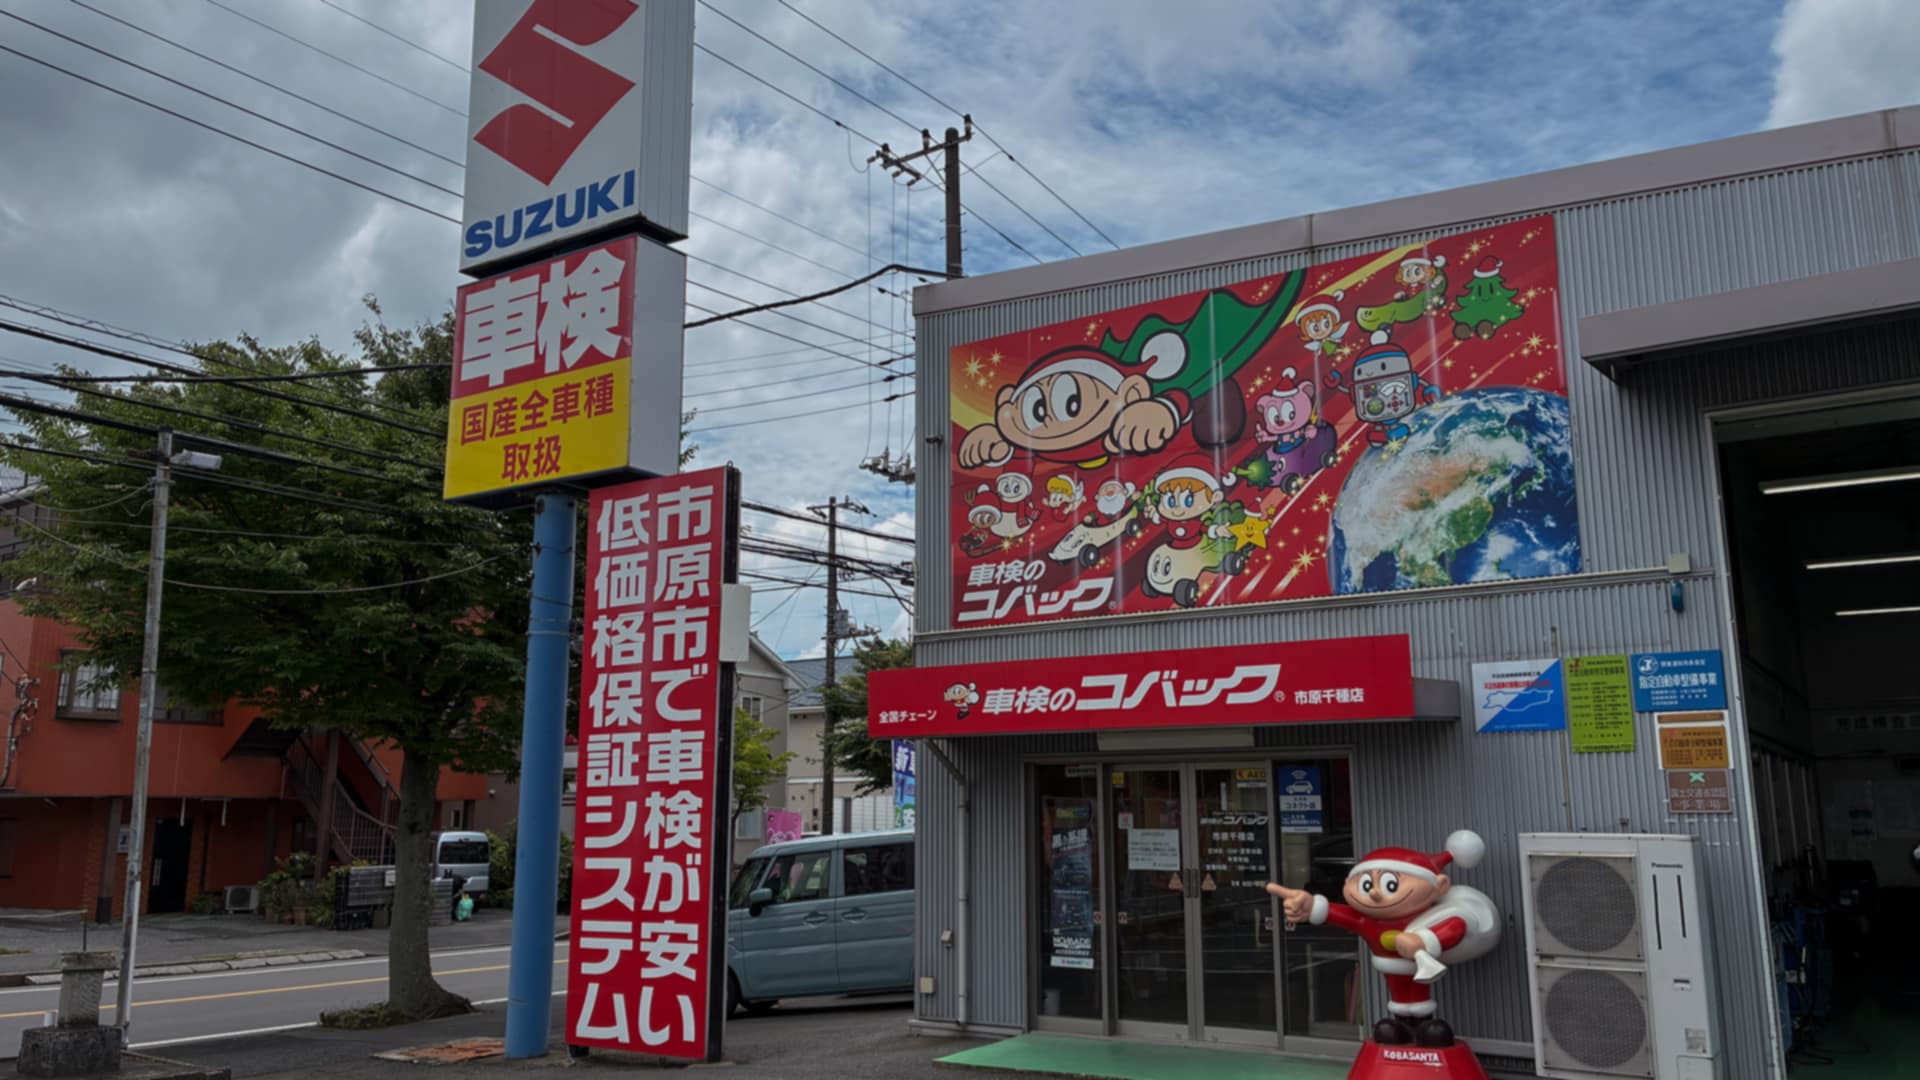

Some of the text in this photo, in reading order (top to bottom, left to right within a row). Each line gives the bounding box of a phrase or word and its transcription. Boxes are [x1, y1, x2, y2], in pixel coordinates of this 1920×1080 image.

[465, 170, 636, 258] SUZUKI
[461, 248, 625, 388] 車検
[460, 373, 614, 445] 国産全車種
[501, 435, 561, 483] 取扱
[958, 578, 1113, 623] コバック
[967, 559, 1045, 587] 車検の
[878, 708, 938, 724] 全国チェーン
[1293, 687, 1365, 705] 市原千種店
[576, 497, 651, 1044] 低価格保証システム
[638, 484, 714, 1045] 市原市で車検が安い
